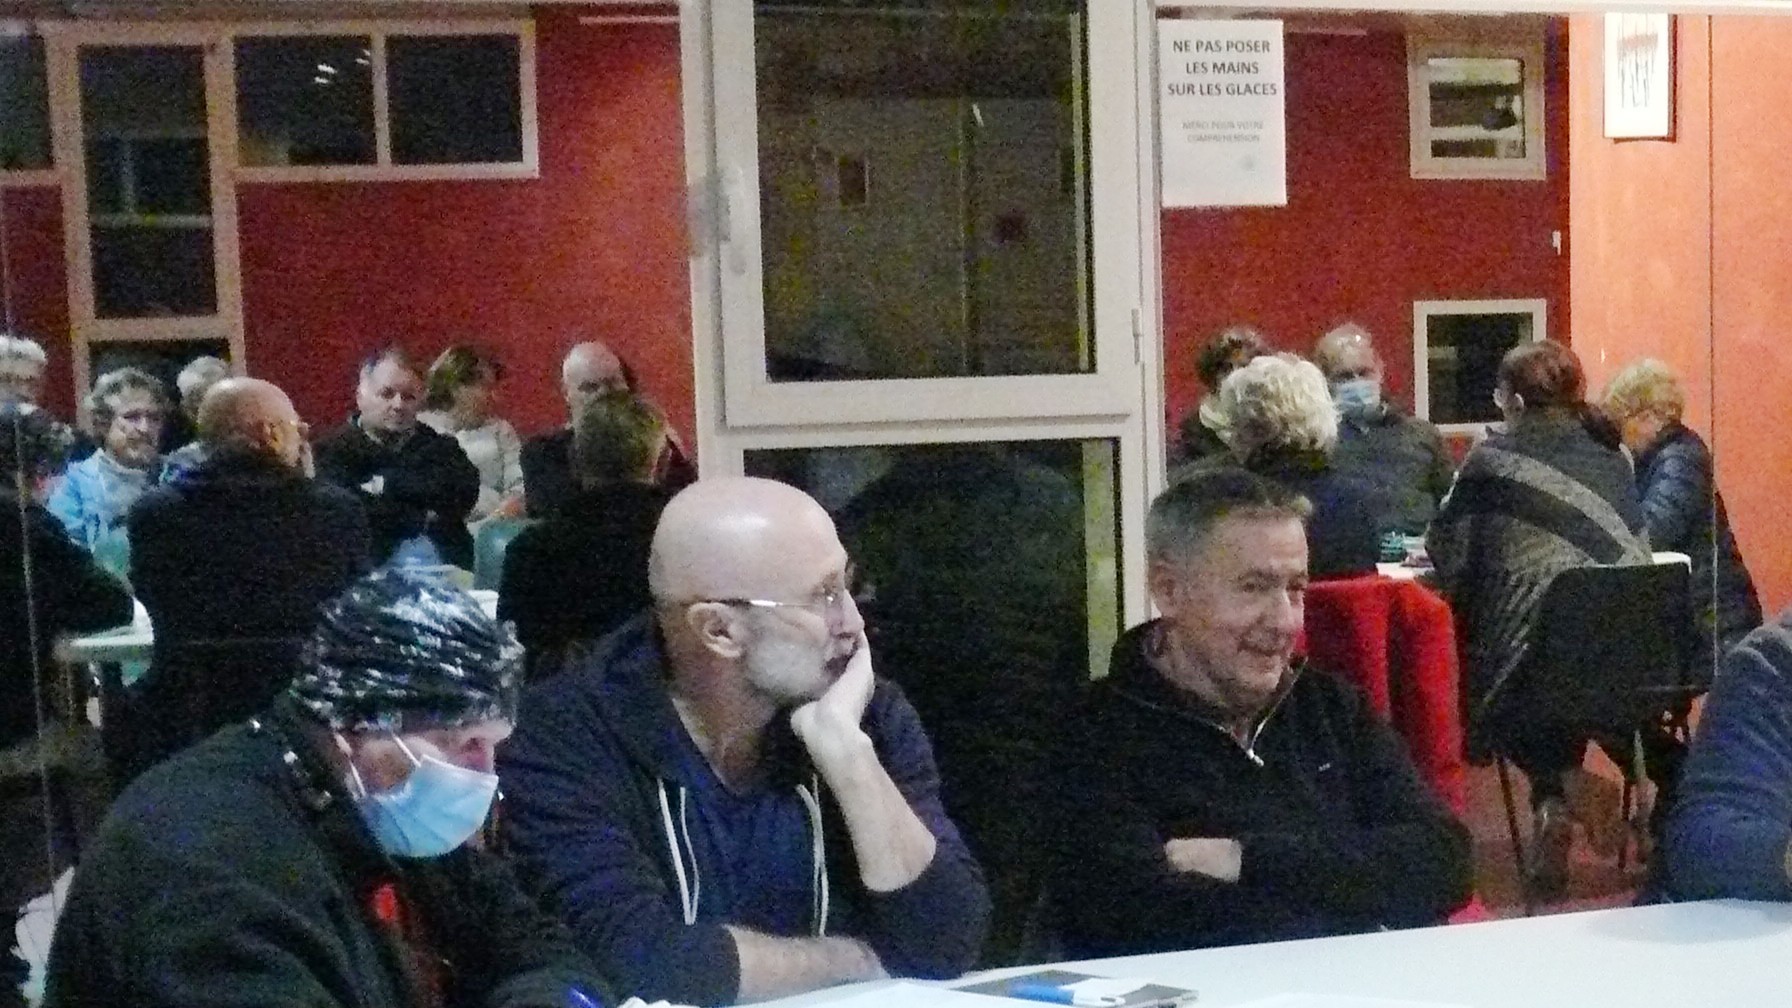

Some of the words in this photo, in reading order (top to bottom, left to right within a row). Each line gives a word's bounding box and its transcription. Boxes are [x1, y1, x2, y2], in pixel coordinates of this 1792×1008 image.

[1173, 40, 1191, 53] NE
[1196, 40, 1222, 53] PAS
[1226, 40, 1271, 53] POSER
[1186, 61, 1208, 74] LES
[1212, 61, 1259, 74] MAINS
[1168, 83, 1195, 96] SUR
[1199, 83, 1222, 96] LES
[1226, 83, 1277, 96] GLACES
